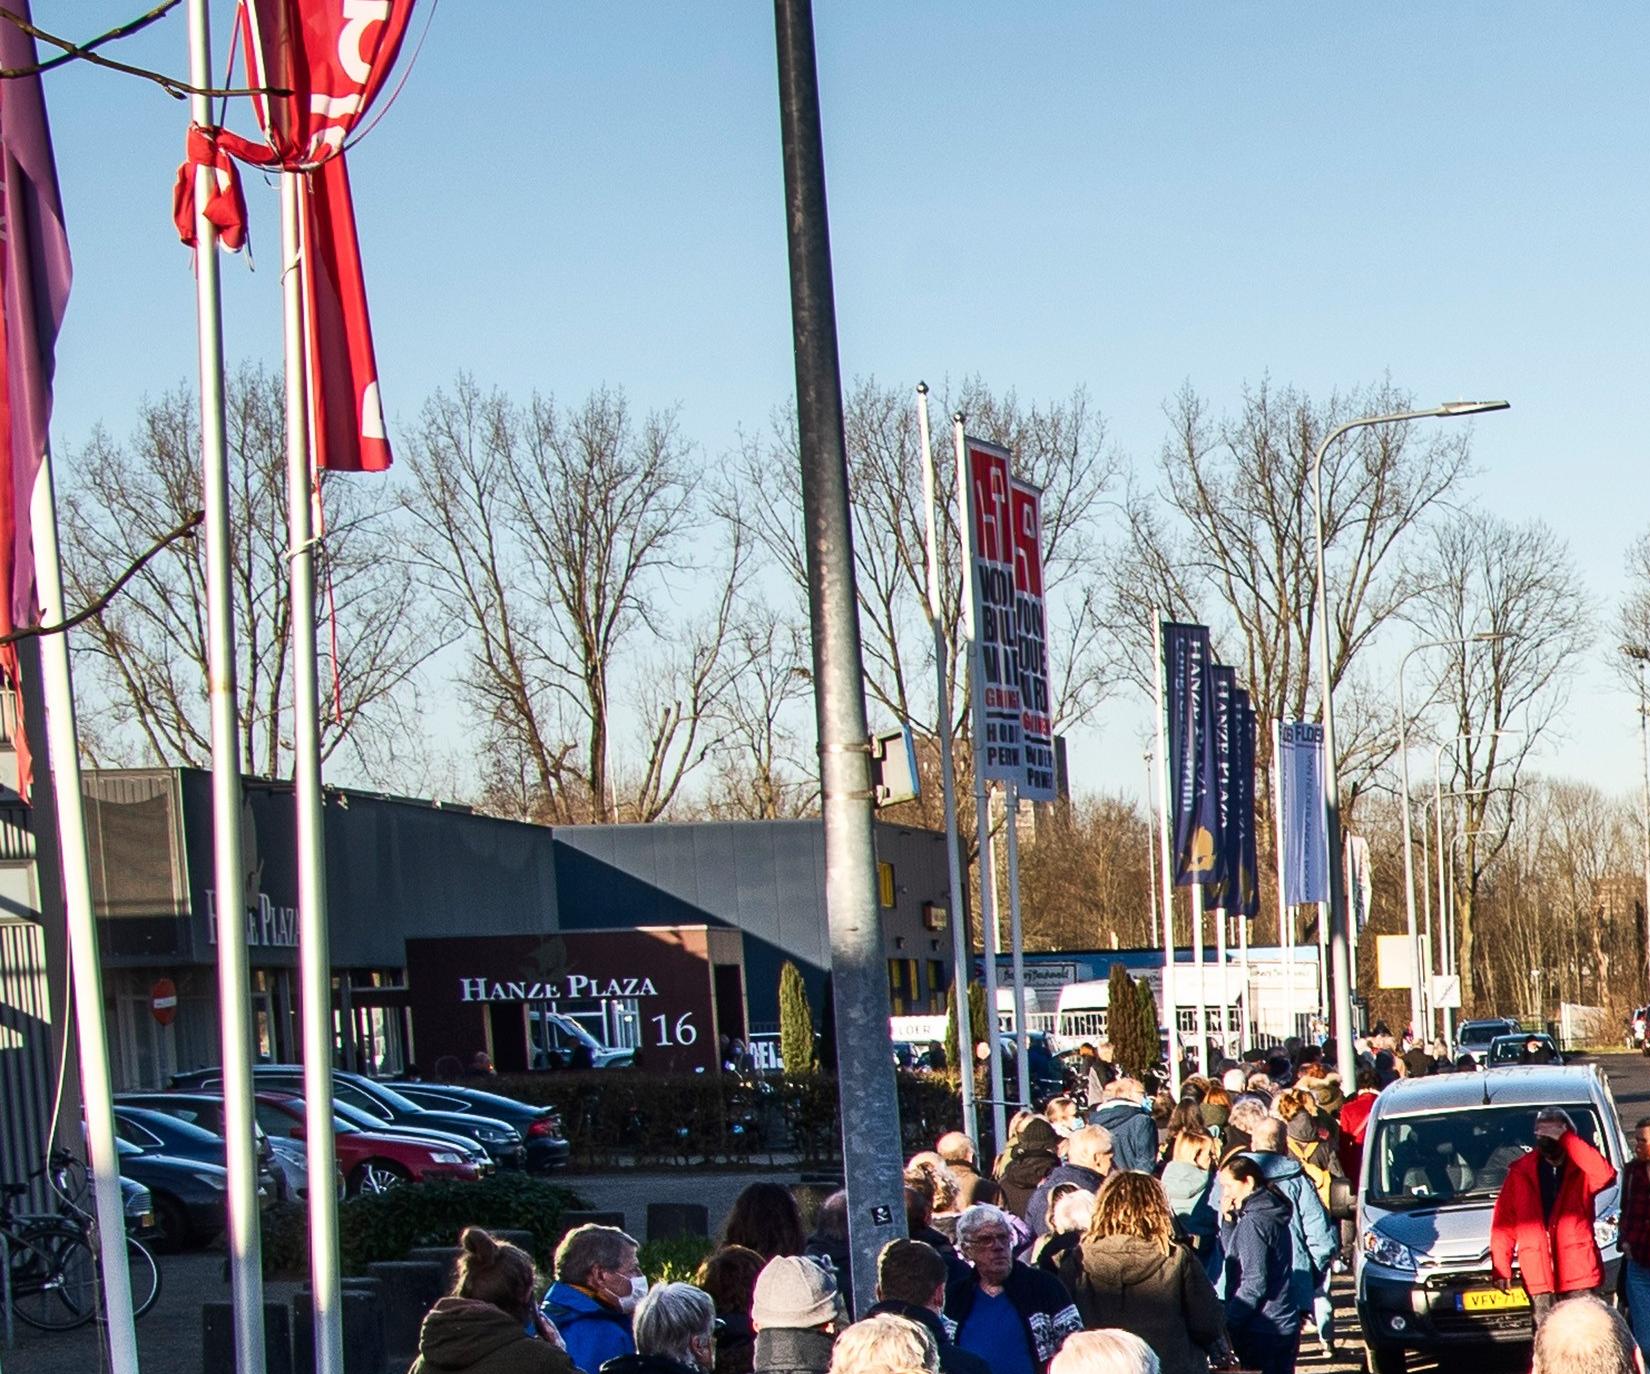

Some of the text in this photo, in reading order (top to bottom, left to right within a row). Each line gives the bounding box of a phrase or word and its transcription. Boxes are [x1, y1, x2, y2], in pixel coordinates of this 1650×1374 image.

[1216, 680, 1230, 755] HANZE
[459, 974, 658, 1002] HANZE PLAZA
[652, 1011, 697, 1047] 16
